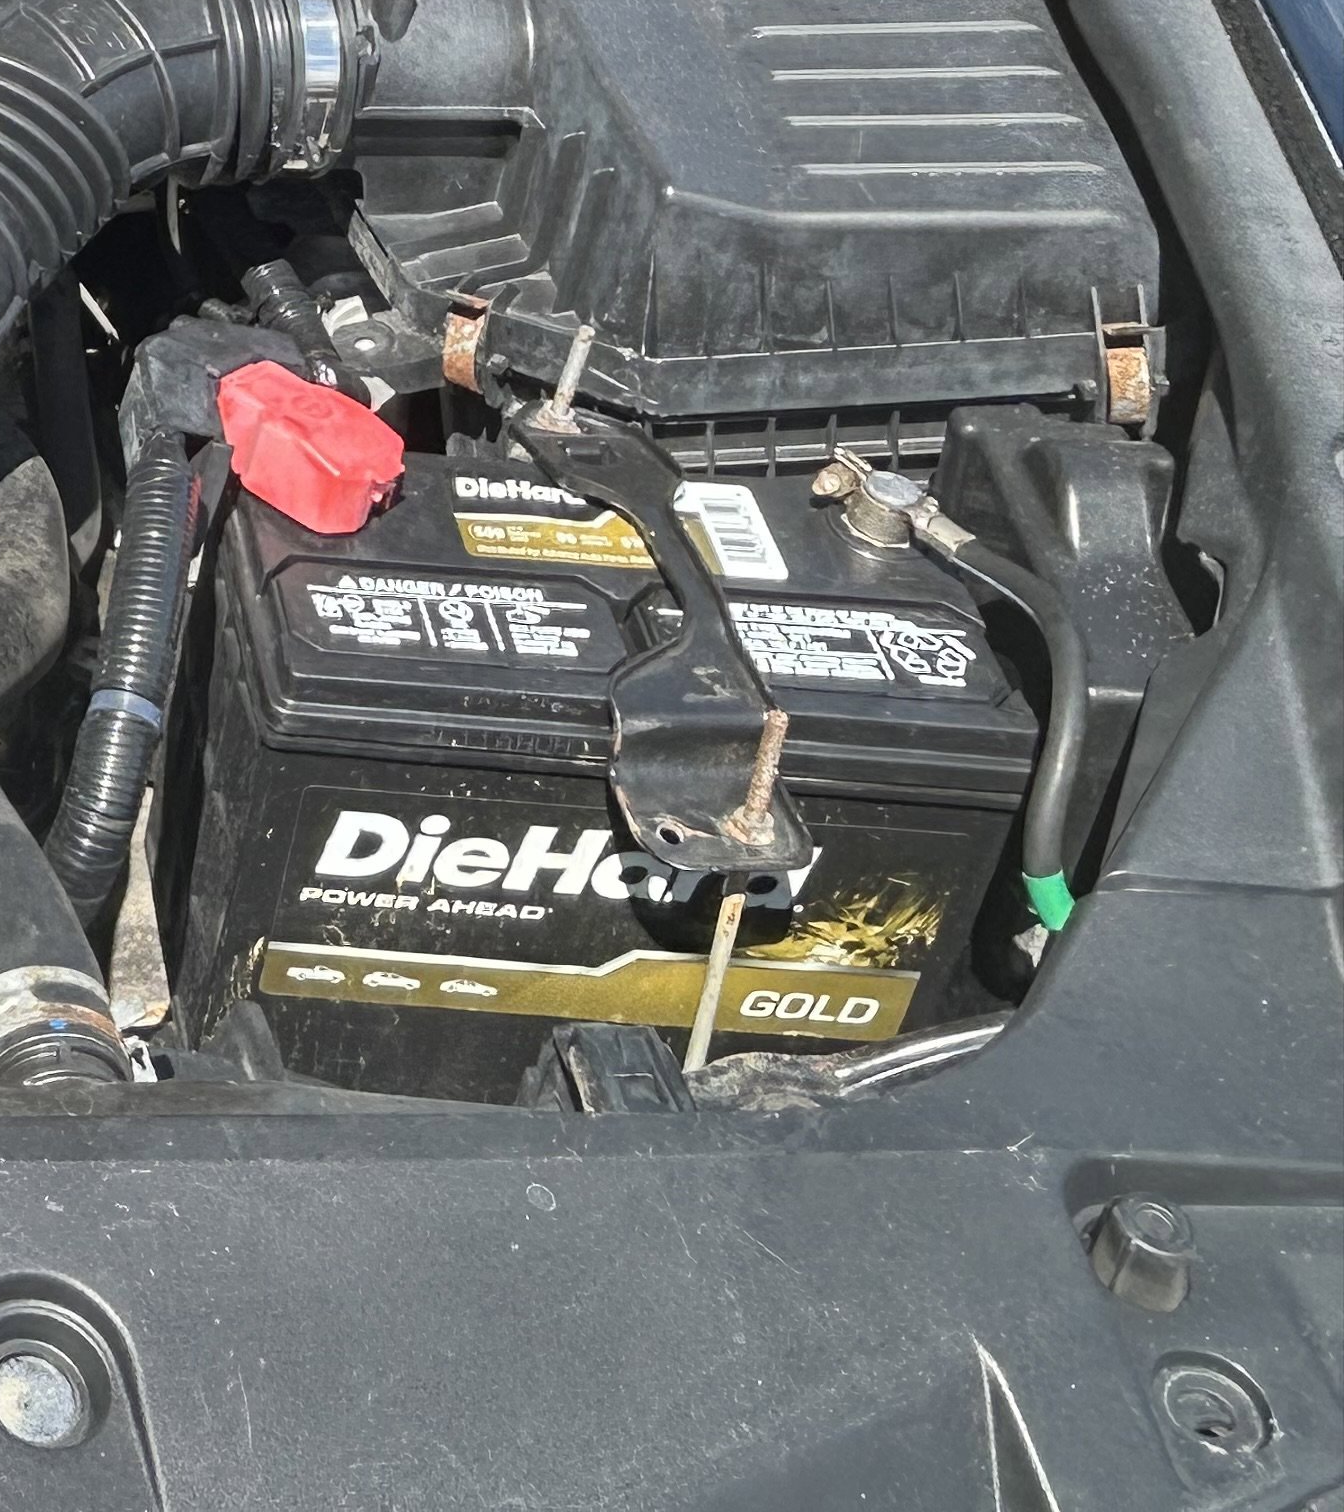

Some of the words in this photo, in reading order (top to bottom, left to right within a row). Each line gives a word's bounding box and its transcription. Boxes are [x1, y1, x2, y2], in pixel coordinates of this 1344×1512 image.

[359, 577, 445, 597] DANGER
[299, 886, 420, 911] POWER
[426, 898, 547, 920] AHEAD
[739, 990, 879, 1024] GOLD
